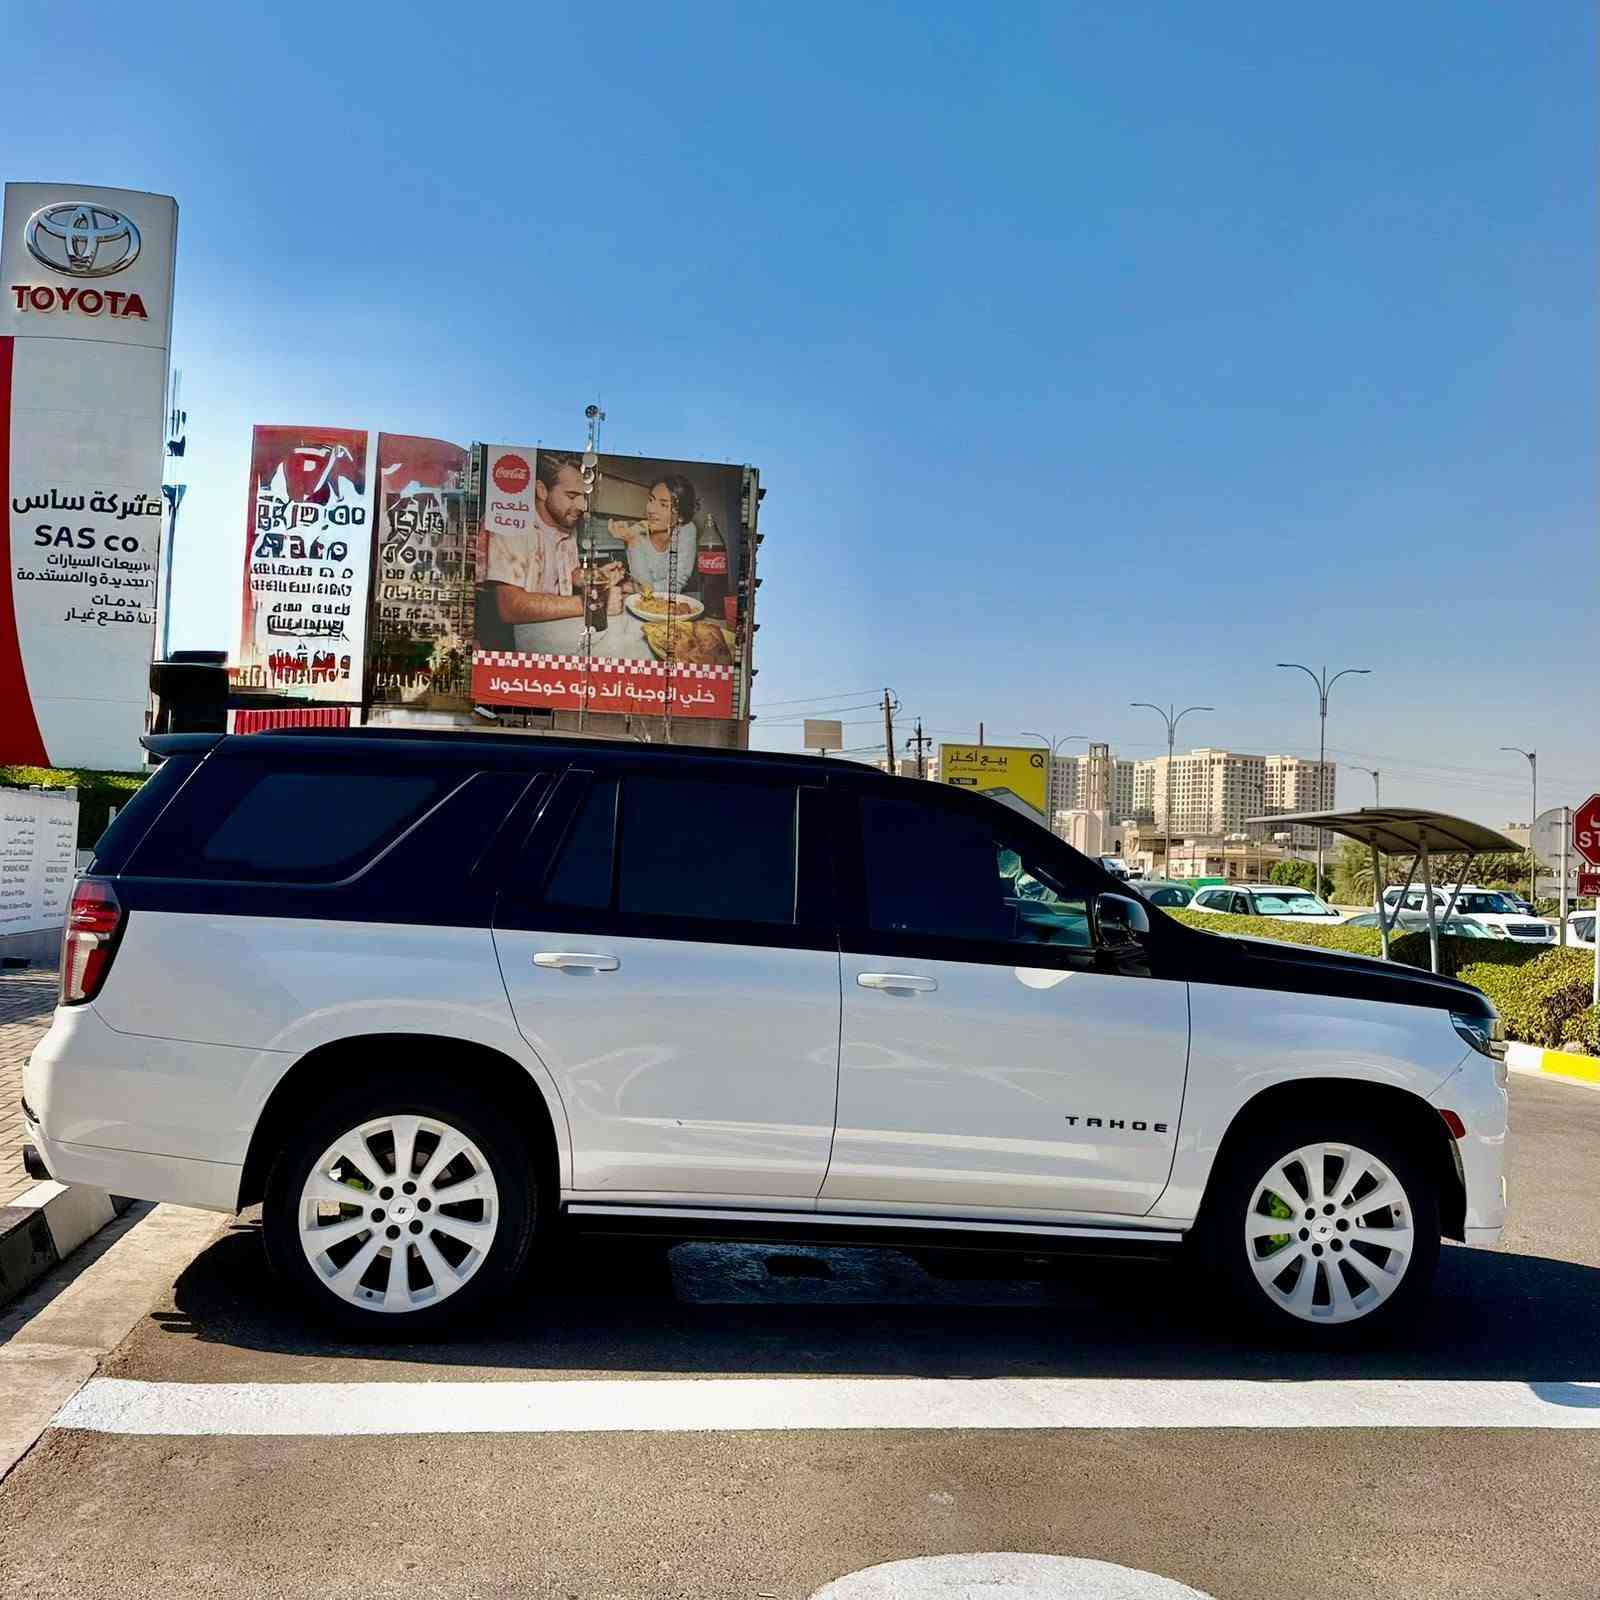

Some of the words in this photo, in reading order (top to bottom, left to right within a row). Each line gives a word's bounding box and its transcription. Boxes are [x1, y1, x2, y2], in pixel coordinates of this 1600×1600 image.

[11, 285, 149, 320] TOYOTA
[12, 488, 86, 514] ساس
[33, 524, 96, 550] SAS
[47, 553, 100, 570] السيارات
[489, 676, 567, 697] كوكاكولا
[1064, 1115, 1169, 1134] TAHOE
